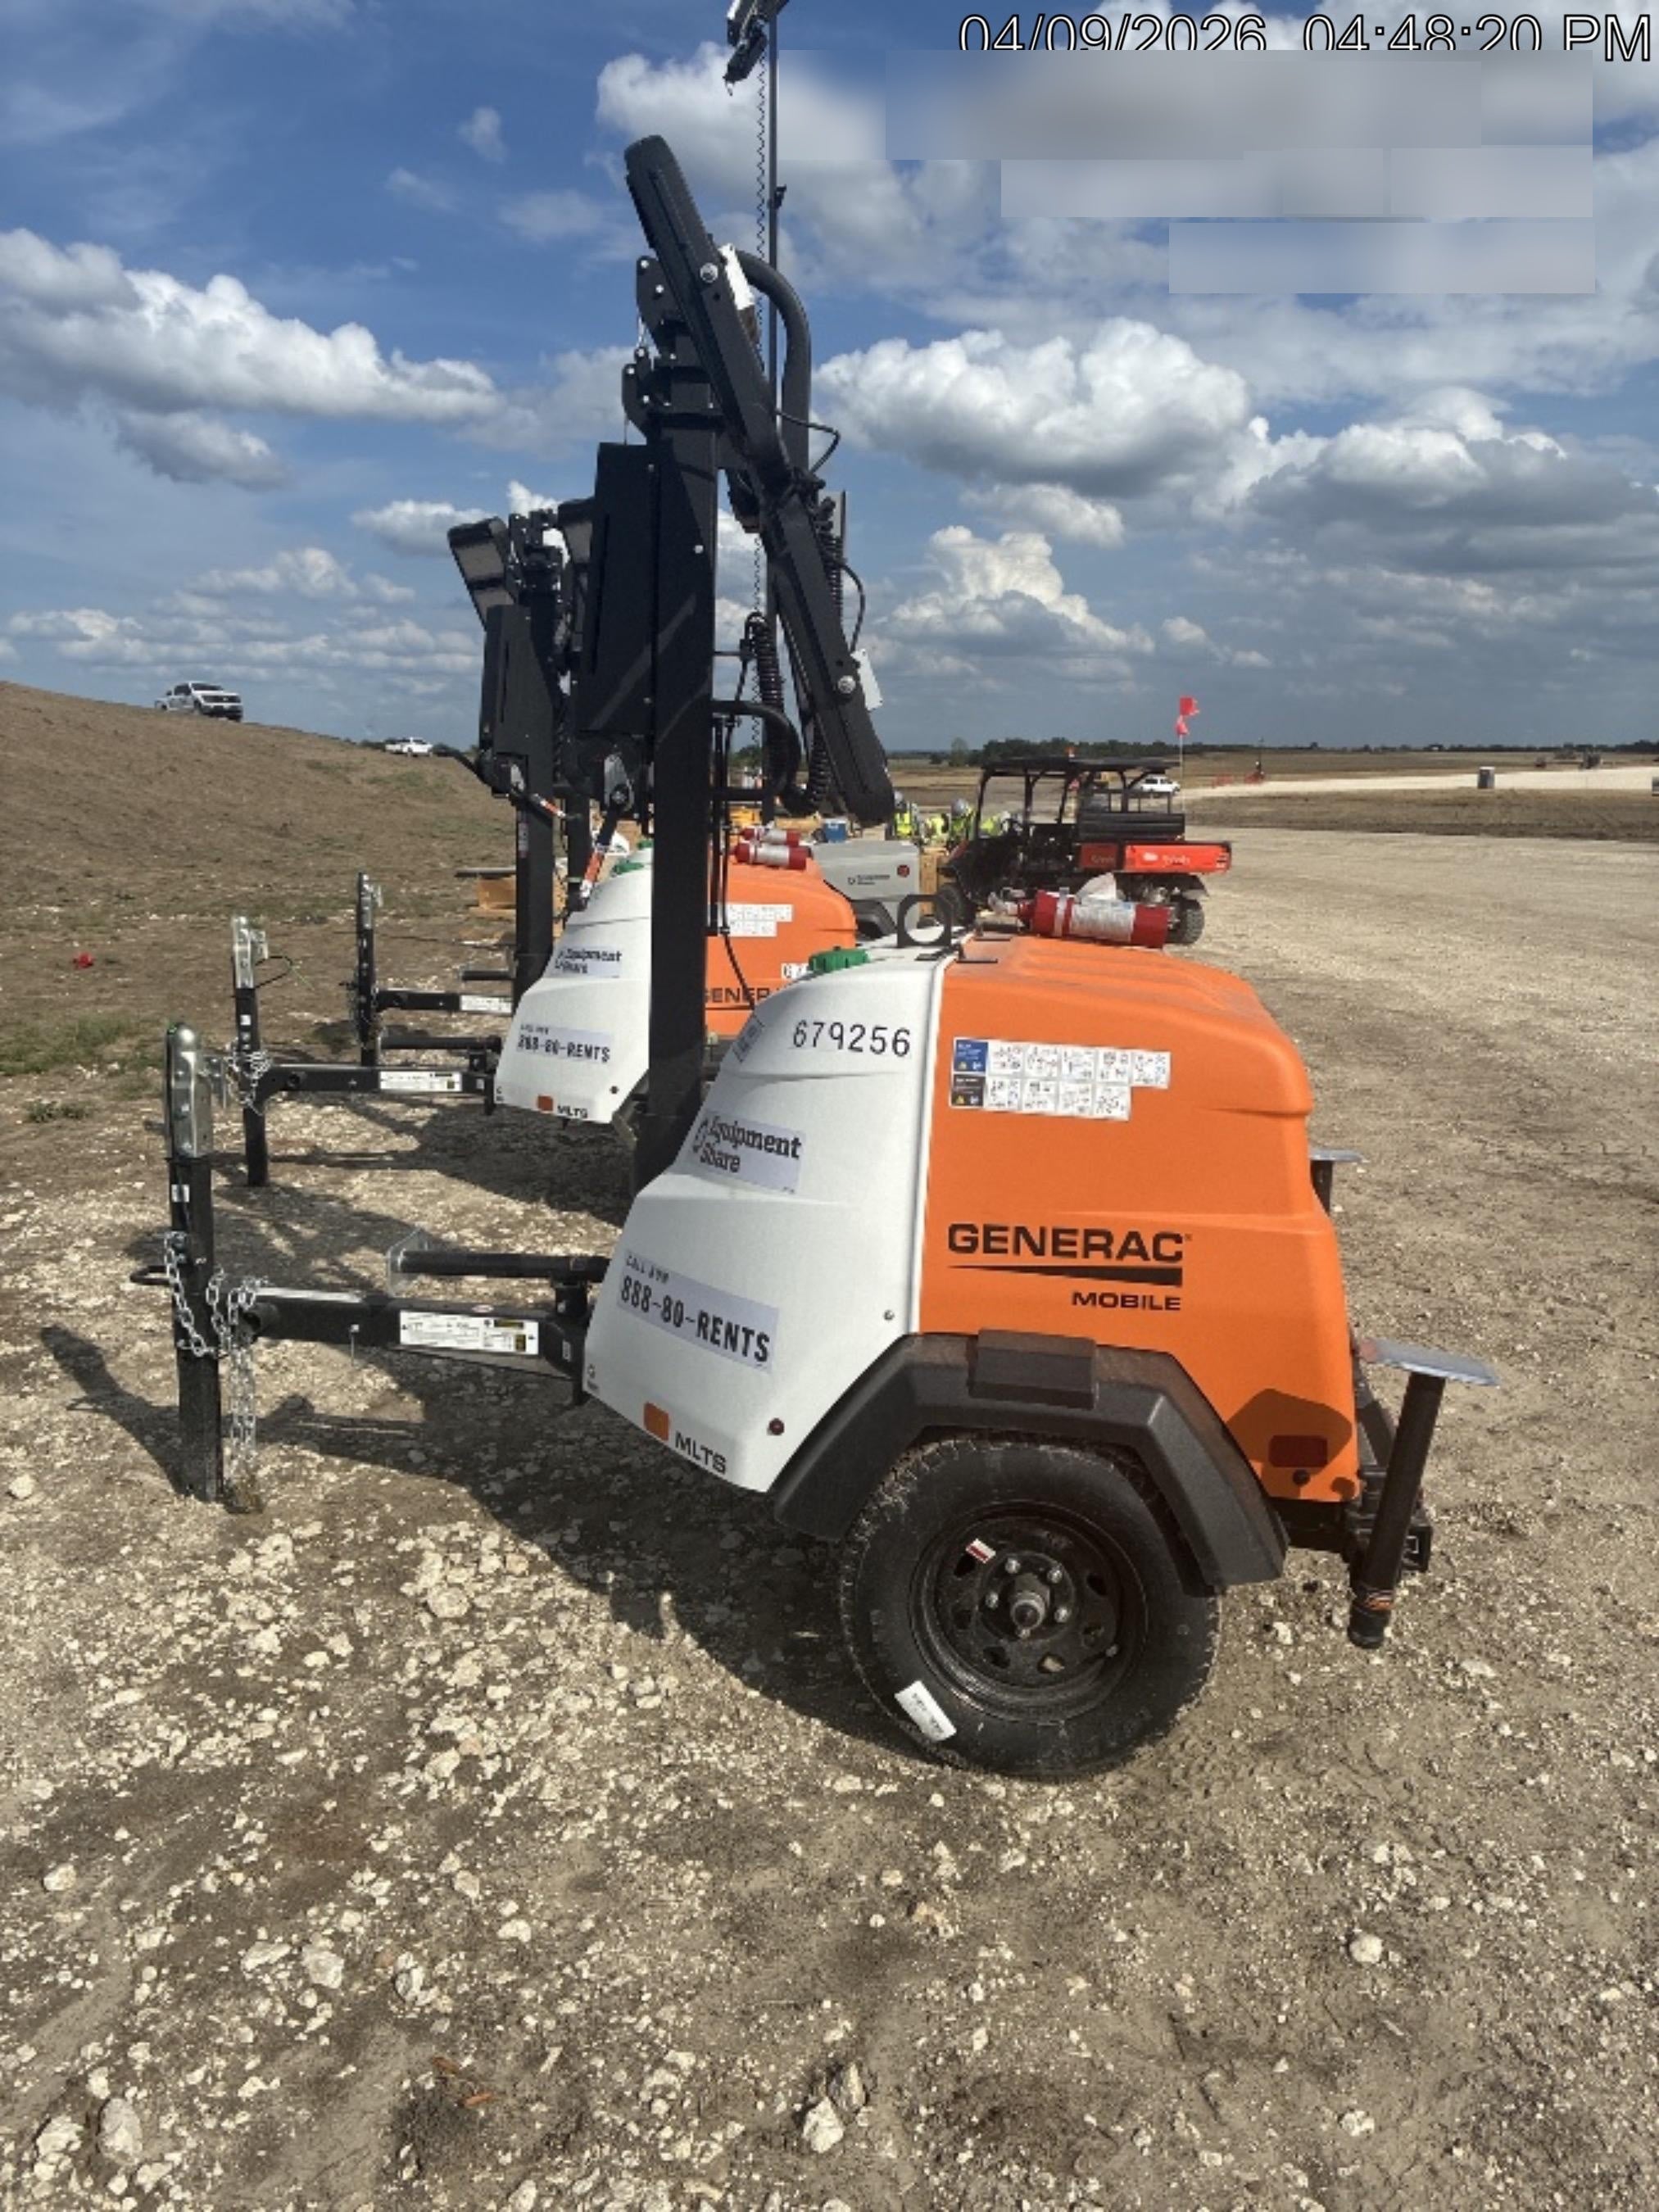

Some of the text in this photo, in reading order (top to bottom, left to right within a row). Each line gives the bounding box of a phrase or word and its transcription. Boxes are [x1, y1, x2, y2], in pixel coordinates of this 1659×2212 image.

[793, 1020, 911, 1057] 679256
[709, 1115, 802, 1159] Equipment
[948, 1223, 1183, 1263] GENERAC
[621, 1275, 770, 1362] 888-80-RENTS
[1072, 1292, 1181, 1311] MOBILE
[674, 1430, 727, 1474] MLTS
